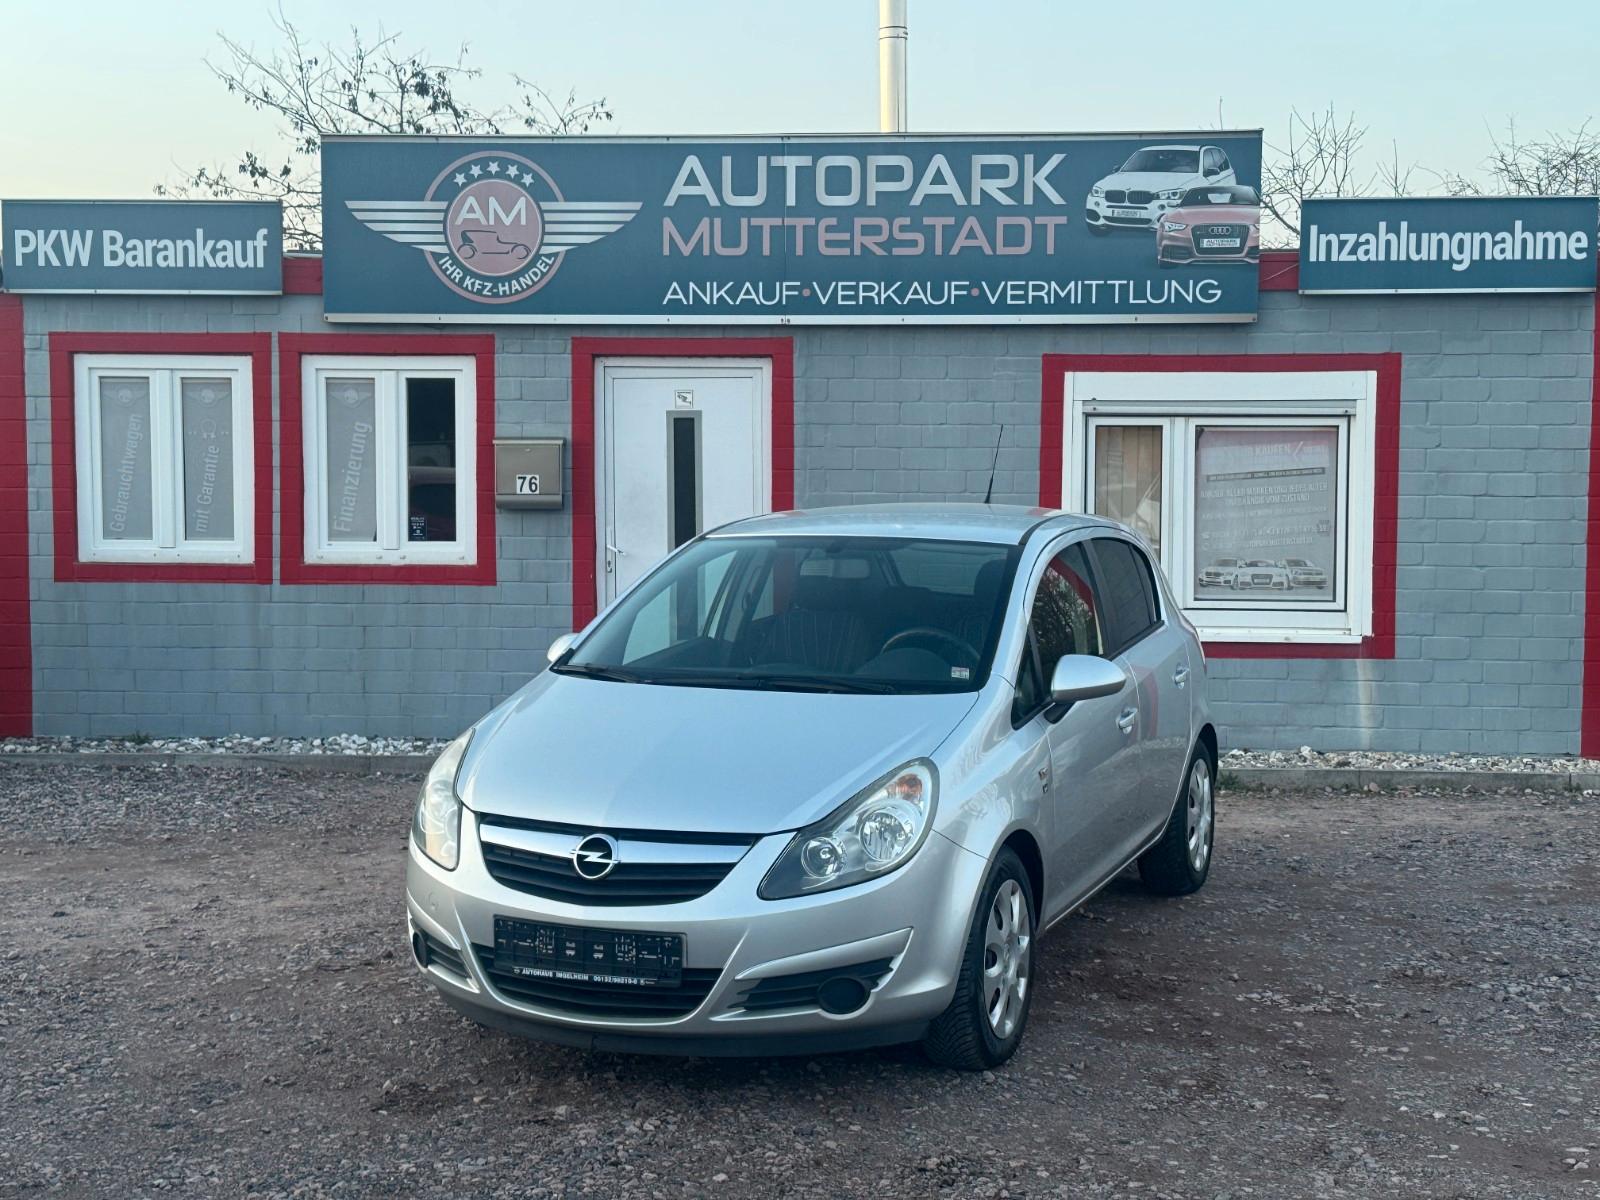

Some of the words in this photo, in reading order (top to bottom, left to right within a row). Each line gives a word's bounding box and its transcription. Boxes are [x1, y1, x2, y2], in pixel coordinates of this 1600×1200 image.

[662, 153, 1067, 207] AUTOPARK
[455, 196, 527, 226] AM
[14, 229, 94, 267] PKW
[102, 228, 268, 268] Barankauf
[662, 216, 1068, 257] MUTTERSTADT
[1309, 220, 1588, 271] Inzahlungnahme
[439, 256, 464, 284] IHR
[463, 256, 555, 296] KFZ-HANDEL
[985, 279, 1223, 304] VERMITTLUNG
[110, 413, 143, 532] Gebrauchtwagen
[197, 445, 219, 506] Garantie
[333, 421, 372, 532] Finanzierung
[517, 476, 538, 493] 76
[193, 509, 210, 533] mit
[522, 968, 553, 977] AUTOHAUS
